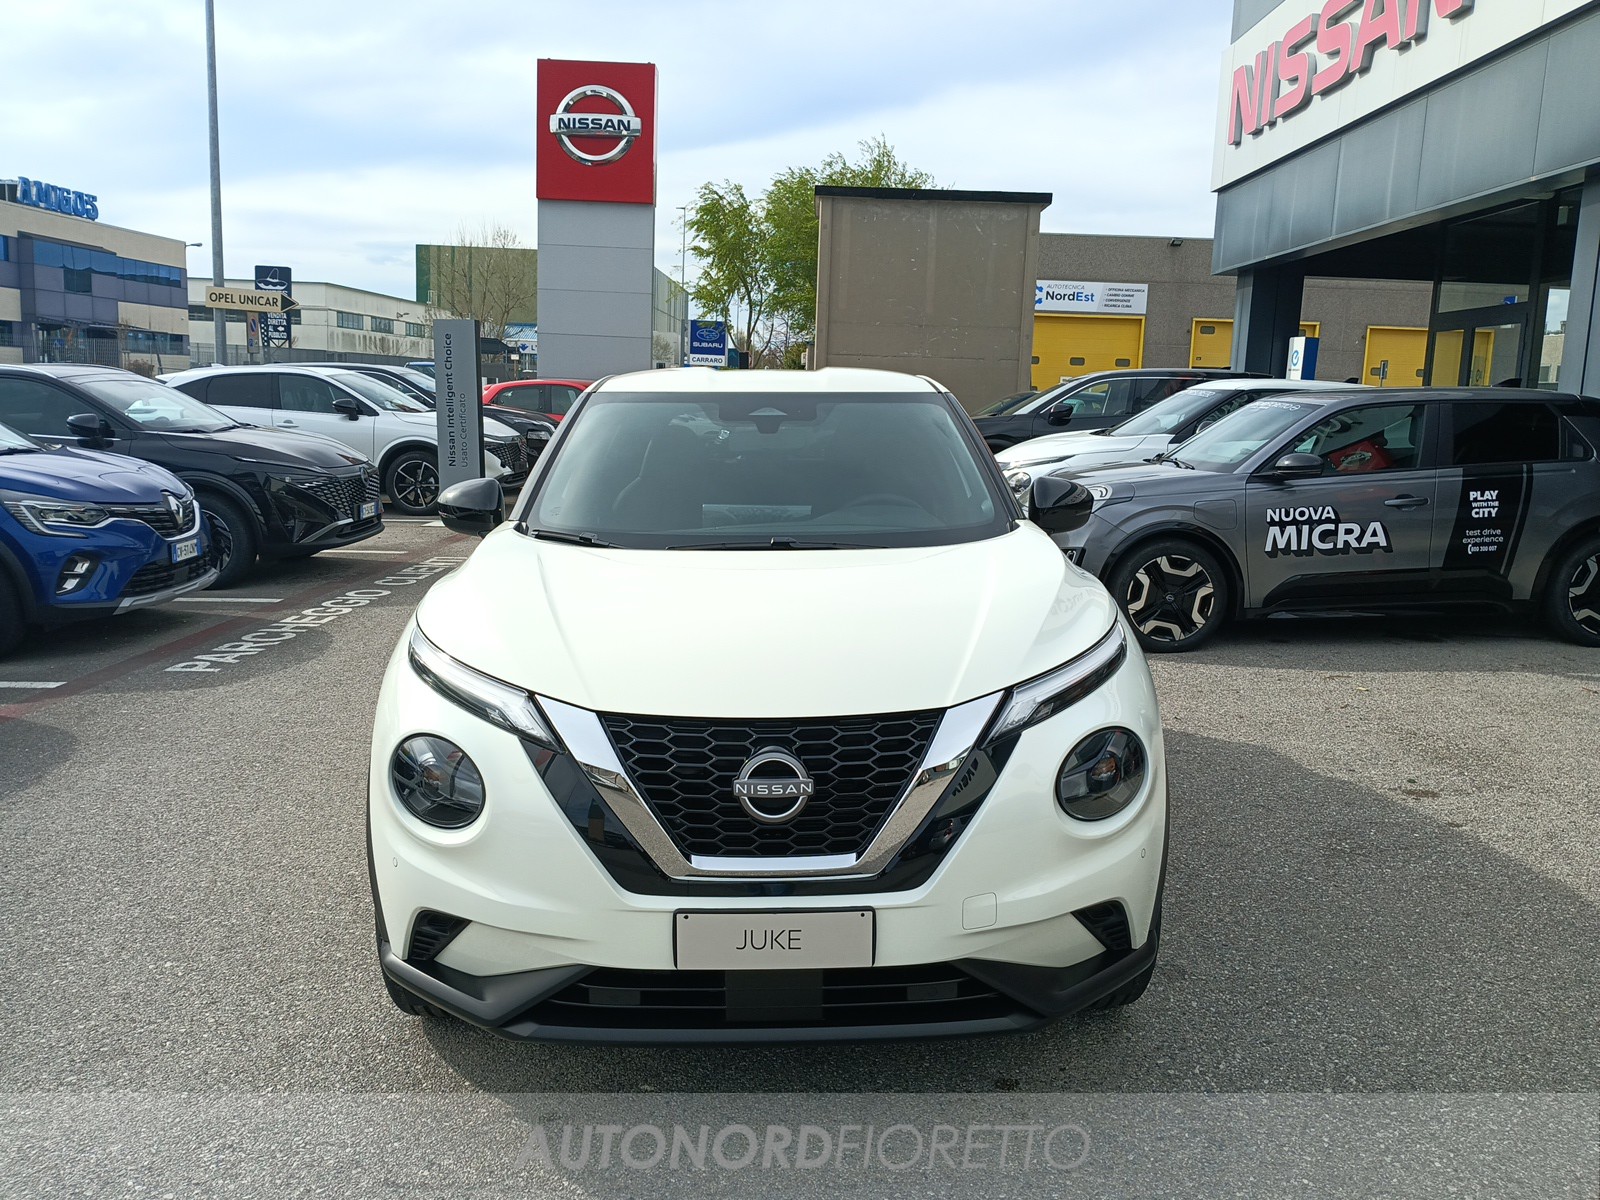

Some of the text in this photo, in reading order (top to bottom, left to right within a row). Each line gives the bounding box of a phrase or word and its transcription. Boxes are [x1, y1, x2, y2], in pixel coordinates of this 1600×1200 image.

[558, 117, 631, 131] NISSAN
[17, 176, 99, 221] AMIGOS
[209, 292, 279, 307] OPEL UNICAR
[1046, 291, 1094, 302] NordEst
[443, 333, 456, 467] Nissan Intelligent Choice
[458, 393, 468, 468] Usato Certificato
[1470, 490, 1498, 500] PLAY
[1266, 506, 1336, 522] NUOVA
[1472, 508, 1498, 518] CITY
[1264, 521, 1387, 552] MICRA
[1462, 536, 1504, 544] experience
[163, 589, 391, 672] PARCHEGGIO
[735, 783, 812, 795] NISSAN
[736, 929, 802, 950] JUKE
